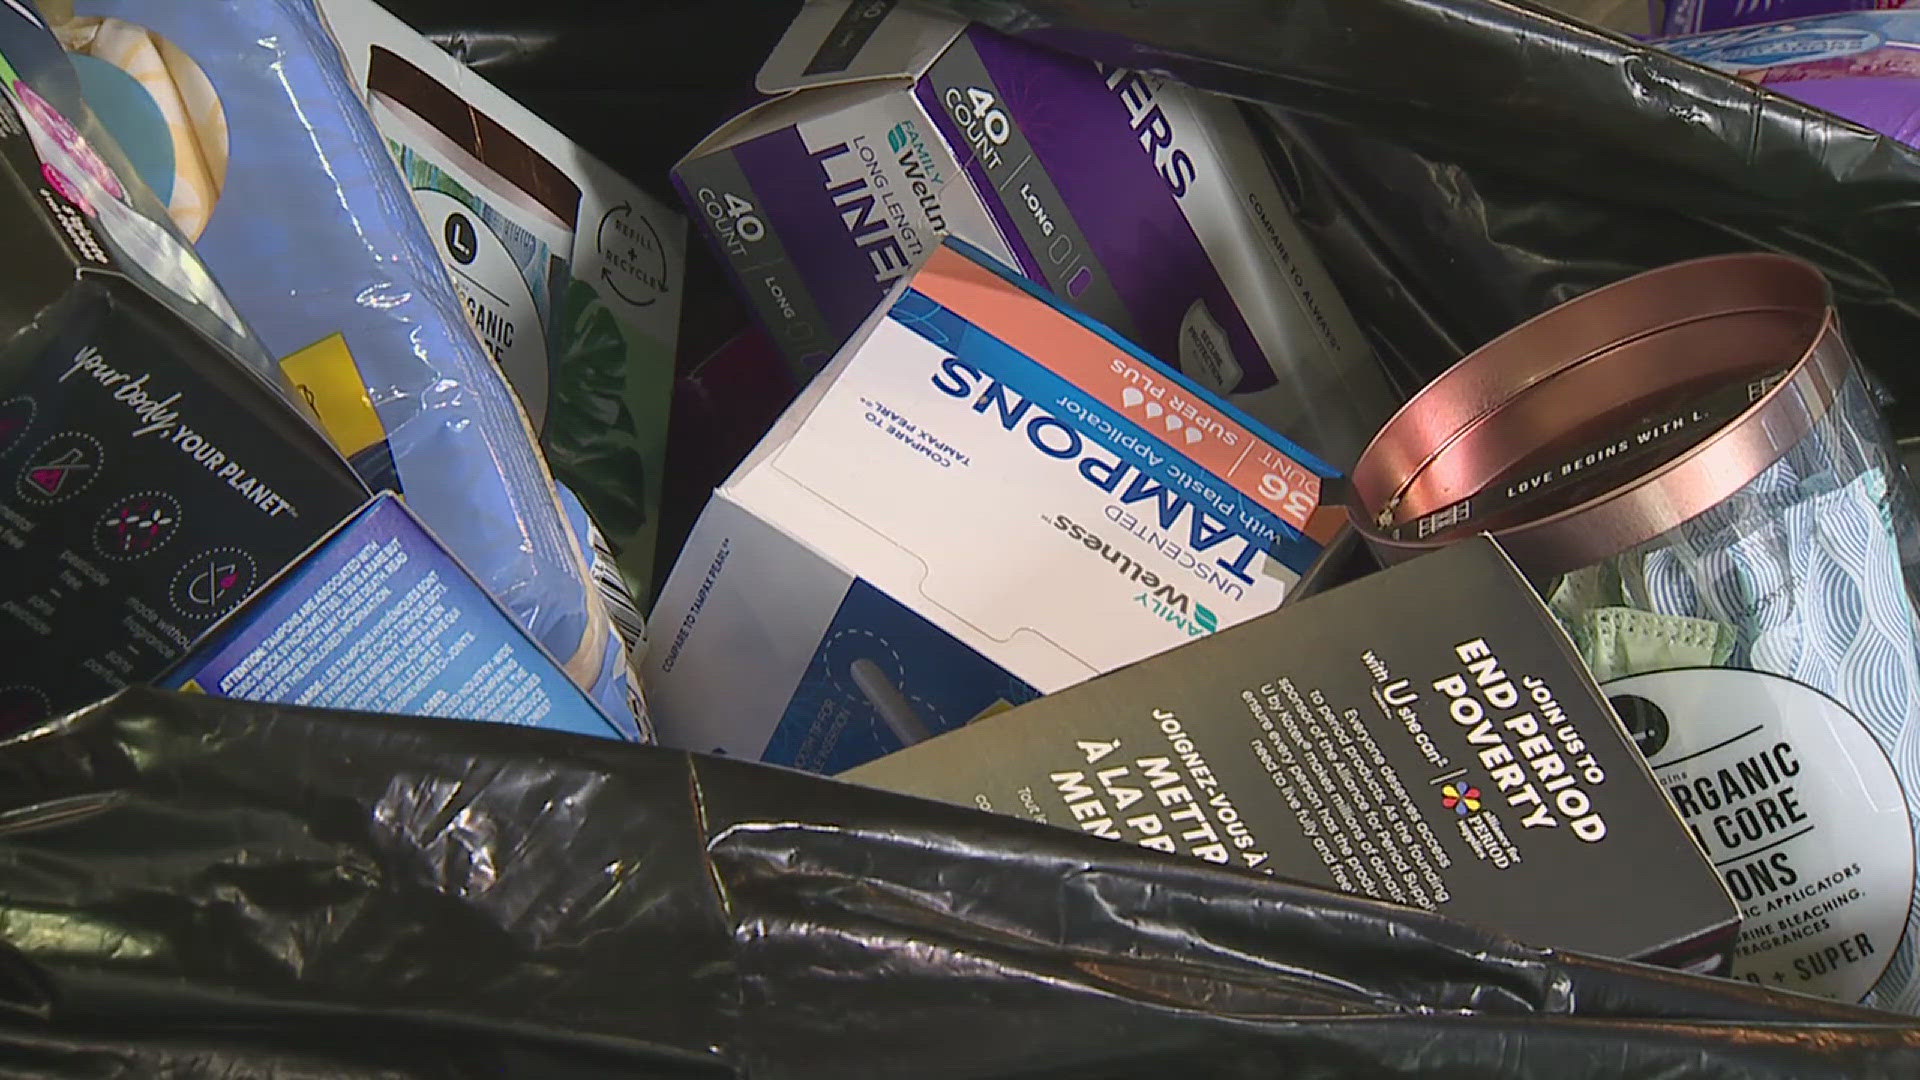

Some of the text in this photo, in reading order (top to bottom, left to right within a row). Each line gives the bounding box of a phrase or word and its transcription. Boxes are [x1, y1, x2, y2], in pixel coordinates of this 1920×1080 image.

[945, 87, 1004, 171] COUNT
[968, 87, 1010, 145] 40
[852, 135, 890, 198] LONG
[902, 120, 943, 184] FAMILY
[724, 192, 764, 242] 40
[811, 140, 911, 285] LINE
[898, 149, 947, 232] Welln
[1020, 183, 1056, 237] LONG
[614, 218, 651, 251] REFILL
[697, 187, 747, 258] COUNT
[1247, 192, 1291, 266] COMPARE
[1288, 264, 1305, 288] TO
[466, 297, 515, 348] GANIC
[766, 276, 796, 320] LONG
[1110, 358, 1239, 448] SUPER PLUS
[171, 424, 226, 470] YOUR
[863, 411, 952, 468] COMPARE TO
[916, 430, 971, 465] TAMPAX
[1506, 471, 1554, 498] LOVE
[1561, 440, 1629, 475] BEGINS
[1637, 417, 1685, 443] WITH
[931, 356, 1268, 587] TAMPONS
[1056, 395, 1283, 545] with Plastic Applicator
[1258, 452, 1320, 500] OUNT
[1258, 472, 1318, 522] 36
[1104, 503, 1244, 602] UNSCENTED
[661, 630, 689, 674] COMPARE
[683, 611, 696, 632] TO
[693, 573, 716, 613] TAMPAX
[1133, 592, 1204, 636] AMILY
[1258, 684, 1273, 695] U
[1264, 696, 1285, 713] by
[1308, 691, 1324, 703] to
[1362, 649, 1389, 684] with
[1398, 704, 1420, 738] she
[1076, 737, 1123, 765] À
[1315, 705, 1352, 746] period
[1432, 671, 1558, 831] POVERTY
[1454, 637, 1608, 843] END PERIOD
[1522, 674, 1607, 788] JOIN US TO
[1098, 766, 1139, 811] LA
[1152, 707, 1255, 863] JOIGNEZ-VOUS
[1240, 690, 1382, 900] ensure every person has the produ
[1276, 677, 1314, 725] sponsor
[1307, 725, 1326, 740] of
[1317, 740, 1339, 760] the
[1330, 760, 1372, 811] Alliance
[1364, 811, 1384, 829] for
[1375, 830, 1410, 870] Period
[1302, 751, 1337, 792] makes
[1341, 744, 1389, 804] products.
[1342, 709, 1387, 765] Everyone
[1379, 765, 1422, 821] deserves
[1414, 822, 1452, 868] access
[1677, 742, 1802, 820] RGANIC
[1250, 739, 1279, 771] need
[1270, 772, 1287, 786] to
[1280, 786, 1303, 808] live
[1292, 809, 1322, 838] fully
[1312, 837, 1338, 863] and
[1328, 792, 1368, 839] millions
[1381, 803, 1400, 821] As
[1714, 787, 1807, 853] CORE
[1359, 840, 1378, 856] of
[1392, 821, 1415, 842] the
[1469, 816, 1511, 871] PERIOD
[1404, 844, 1452, 902] founding
[1727, 849, 1797, 902] ONS
[1764, 862, 1862, 908] APPLICATORS
[1737, 925, 1775, 946] RINE
[1794, 933, 1875, 982] SUPER
